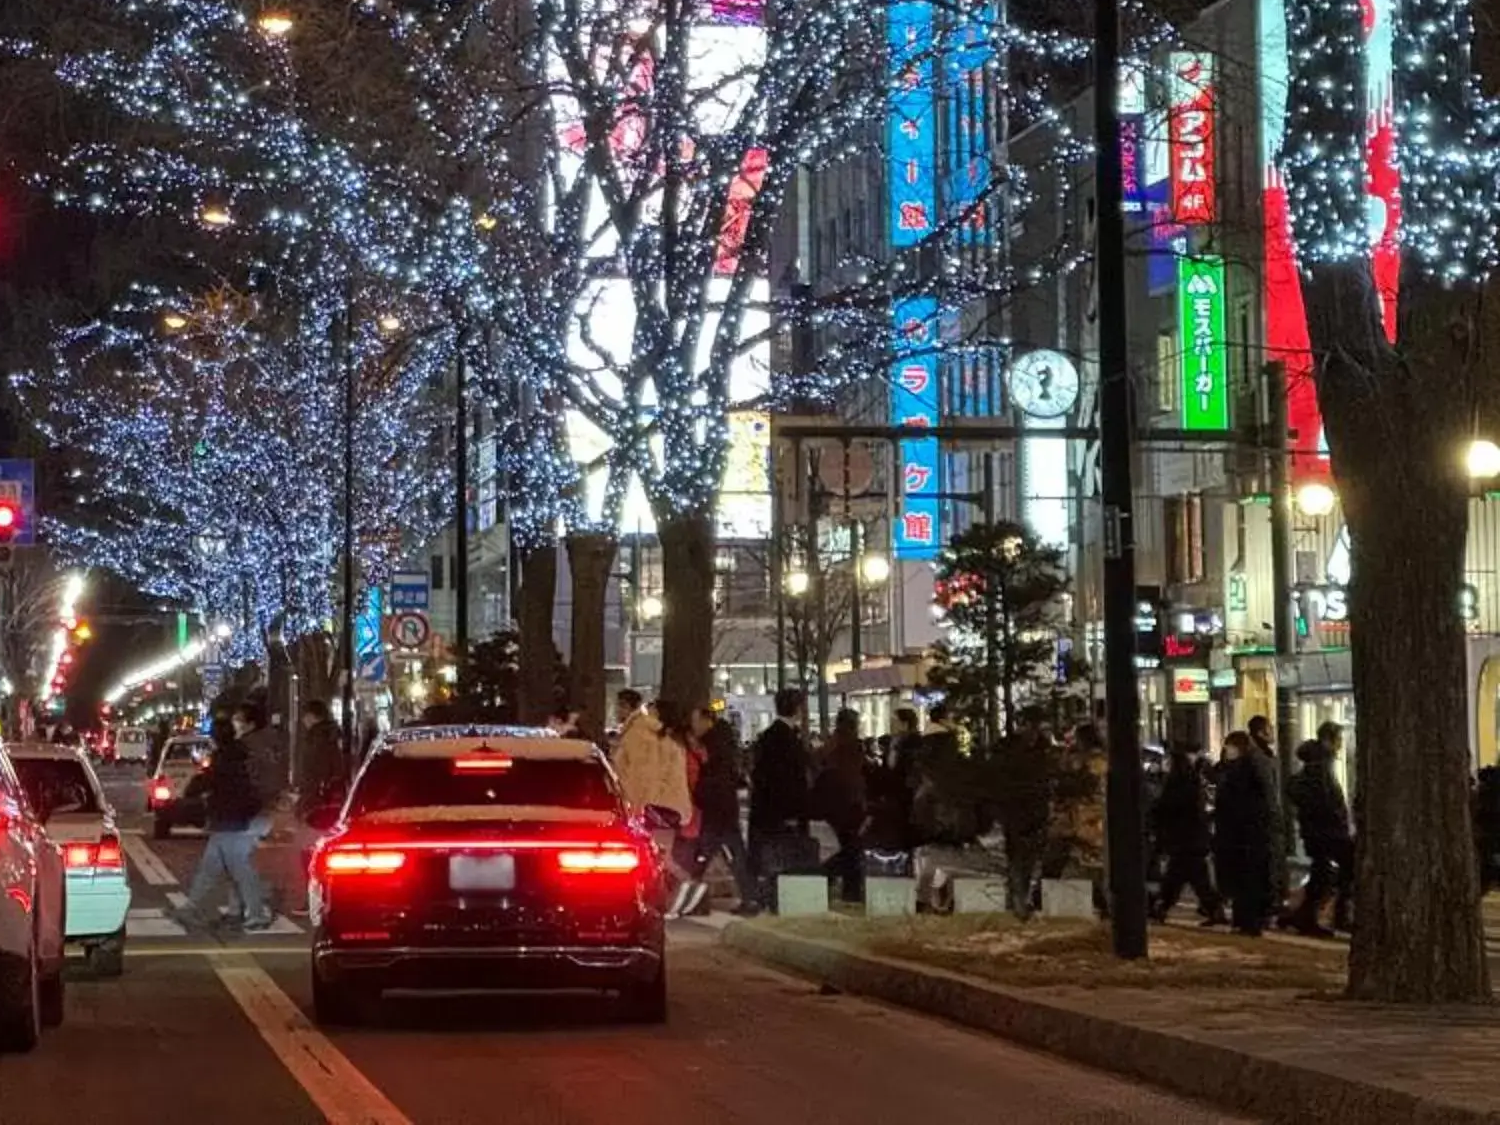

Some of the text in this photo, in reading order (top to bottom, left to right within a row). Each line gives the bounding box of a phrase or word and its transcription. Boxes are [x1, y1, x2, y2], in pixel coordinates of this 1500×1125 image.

[1181, 194, 1205, 209] 4F
[1192, 298, 1213, 412] モスバーガー
